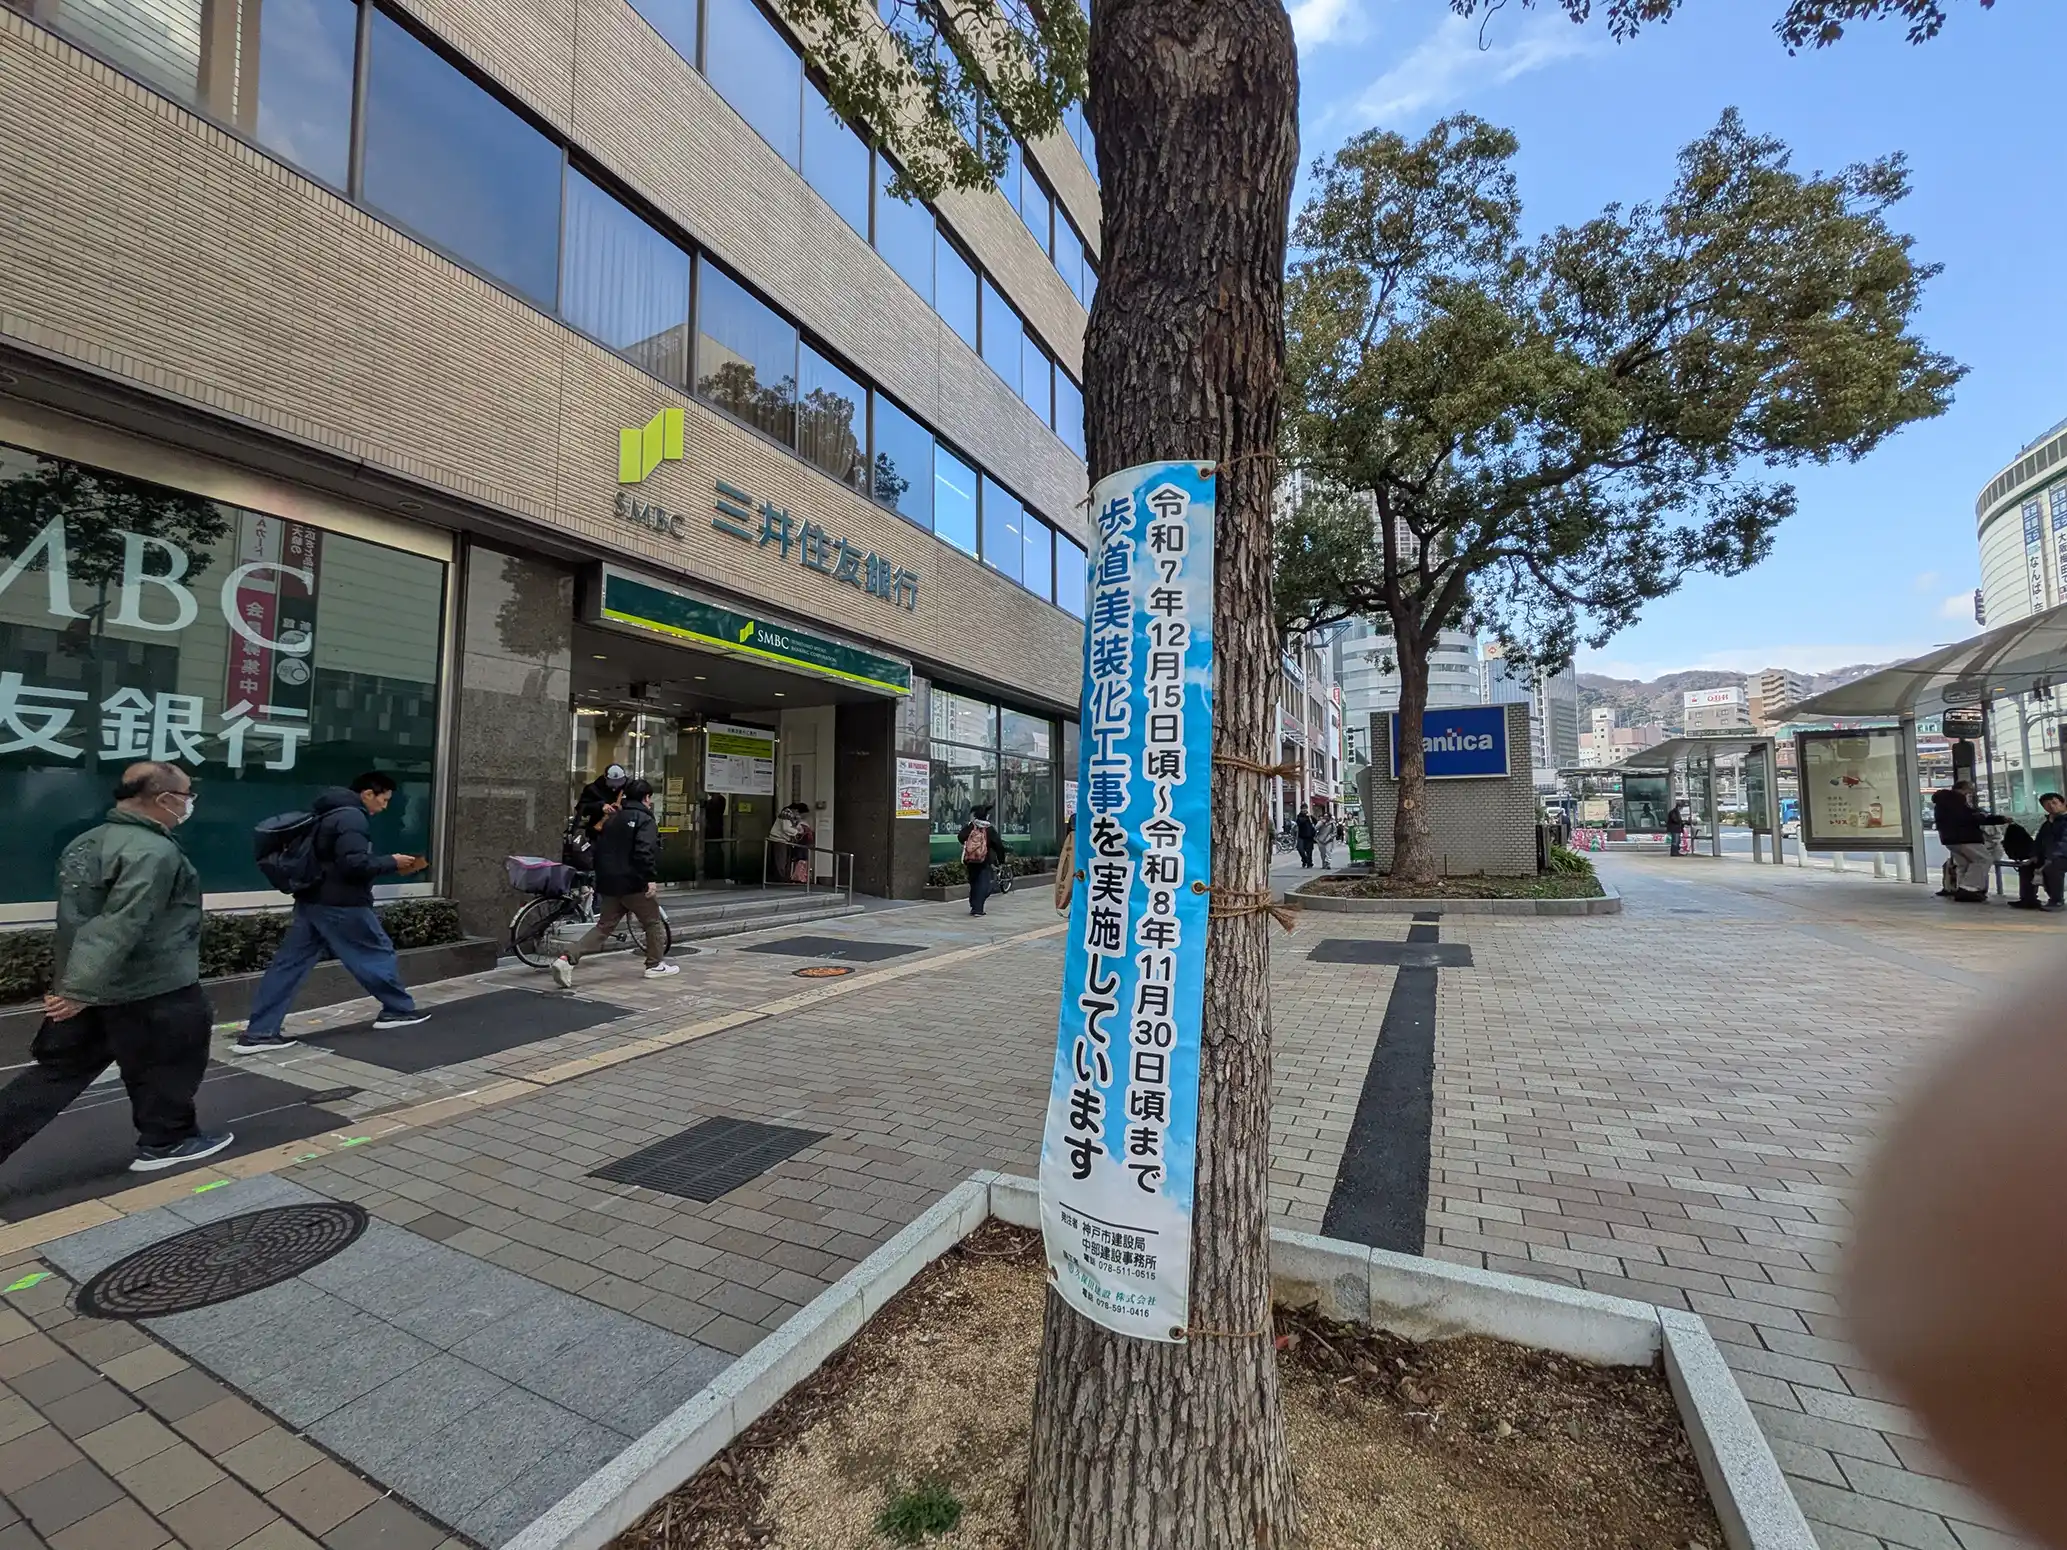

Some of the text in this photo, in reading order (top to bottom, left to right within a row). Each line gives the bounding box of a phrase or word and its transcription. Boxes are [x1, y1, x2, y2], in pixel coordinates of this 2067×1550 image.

[614, 490, 686, 539] SMBC
[711, 478, 918, 610] 三井住友銀行
[757, 629, 790, 650] SMBC
[1422, 730, 1493, 753] antica
[1064, 497, 1131, 1180] 歩道美装化工事を実施しています
[1082, 1221, 1145, 1252] 神戸市建設局
[1082, 1238, 1157, 1271] 中部建設事務所
[1098, 1260, 1156, 1281] 078-511-0515
[1096, 1298, 1150, 1318] 078-591-0416
[1116, 1291, 1157, 1306] 株式会社
